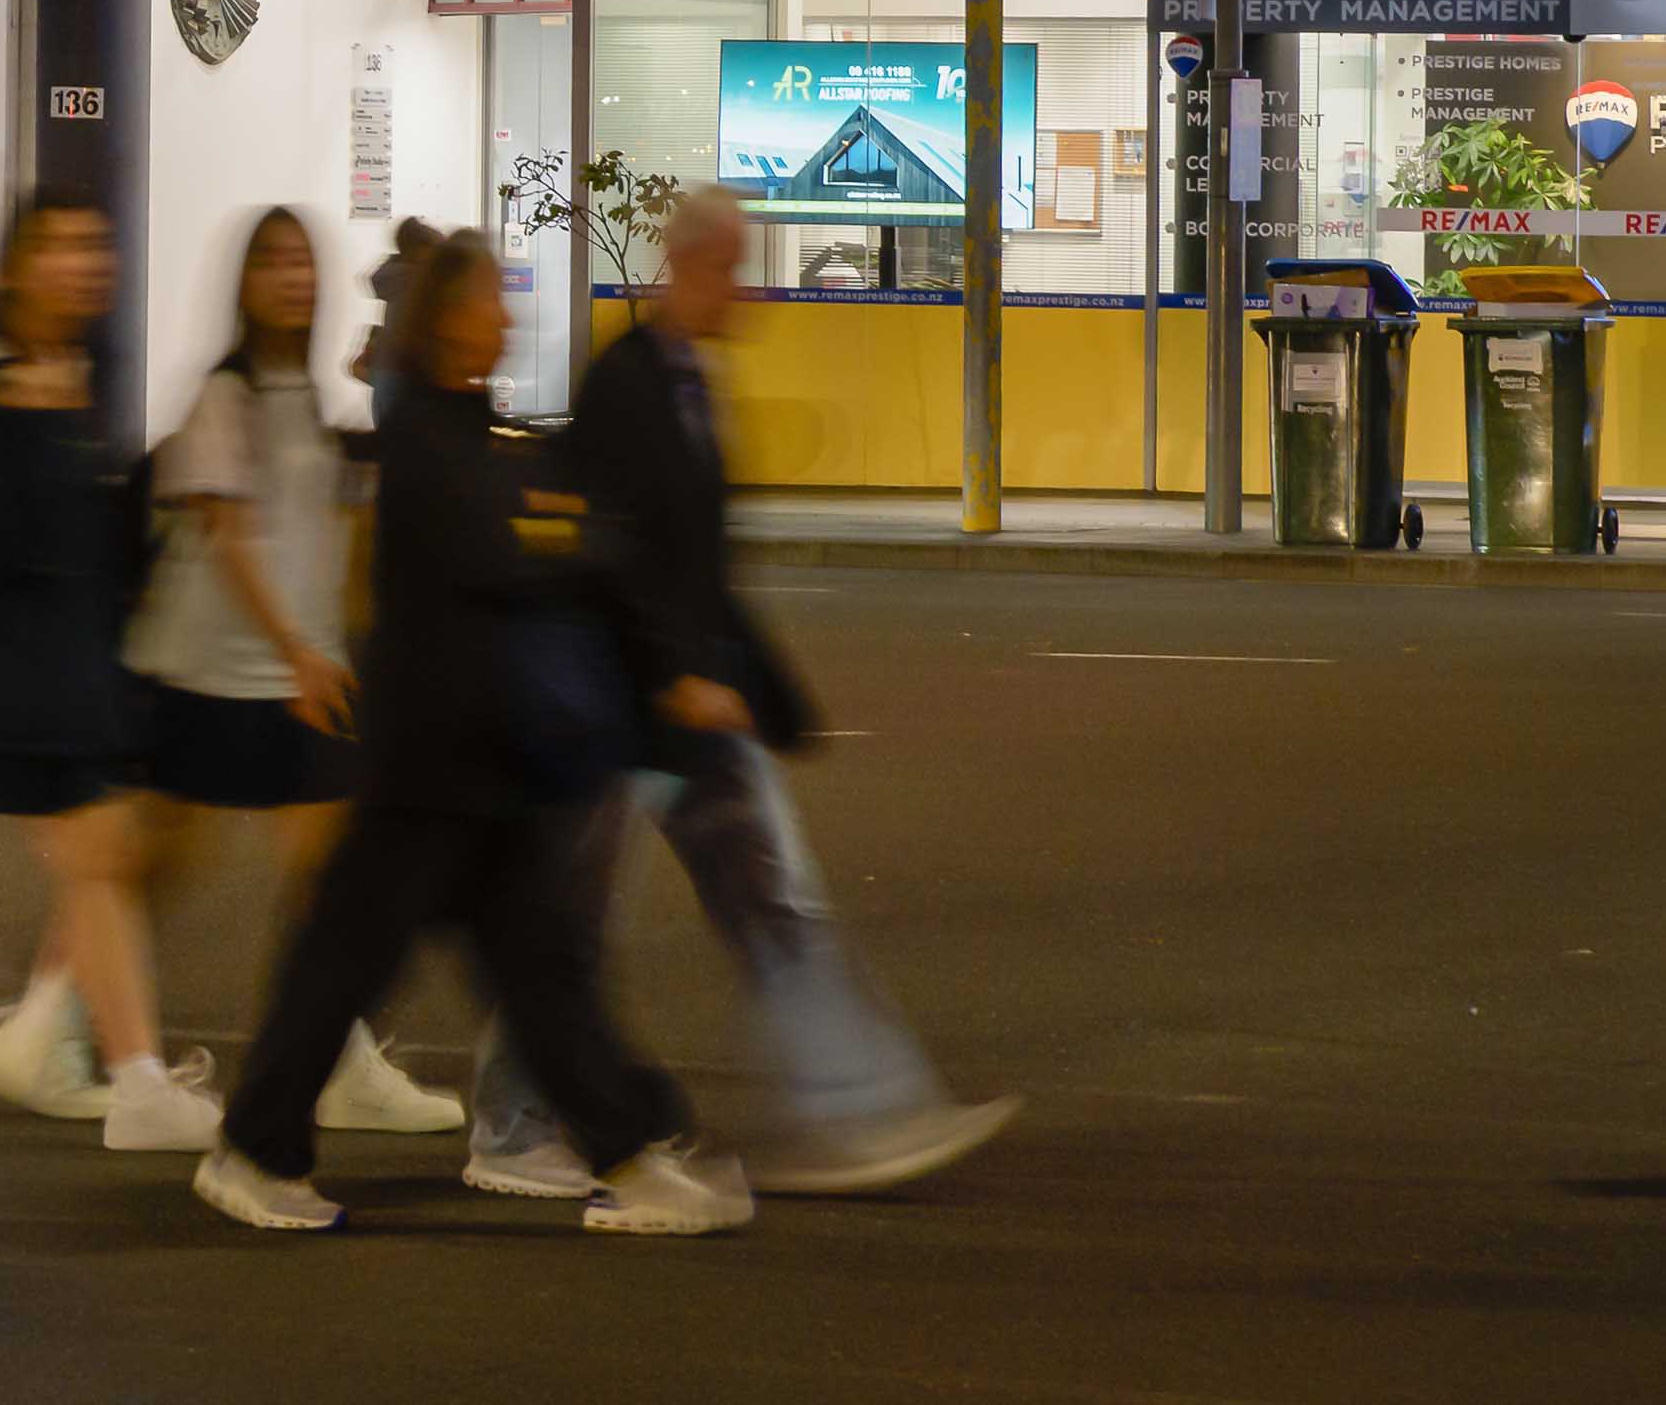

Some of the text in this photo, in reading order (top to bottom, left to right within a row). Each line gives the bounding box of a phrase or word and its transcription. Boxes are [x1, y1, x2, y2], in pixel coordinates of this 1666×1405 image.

[1164, 0, 1322, 21] PRERTY
[1411, 55, 1562, 71] PRESTIGE HOMES
[1411, 87, 1495, 102] PRESTIGE
[53, 90, 100, 117] 136
[1575, 100, 1629, 116] RE/MAX
[1186, 113, 1325, 127] MAEMENT
[1411, 107, 1536, 123] MANAGEMENT
[1246, 222, 1365, 237] CORPORATE
[1421, 211, 1531, 232] RE/MAX
[1001, 294, 1125, 309] remaxprestige.co.nz
